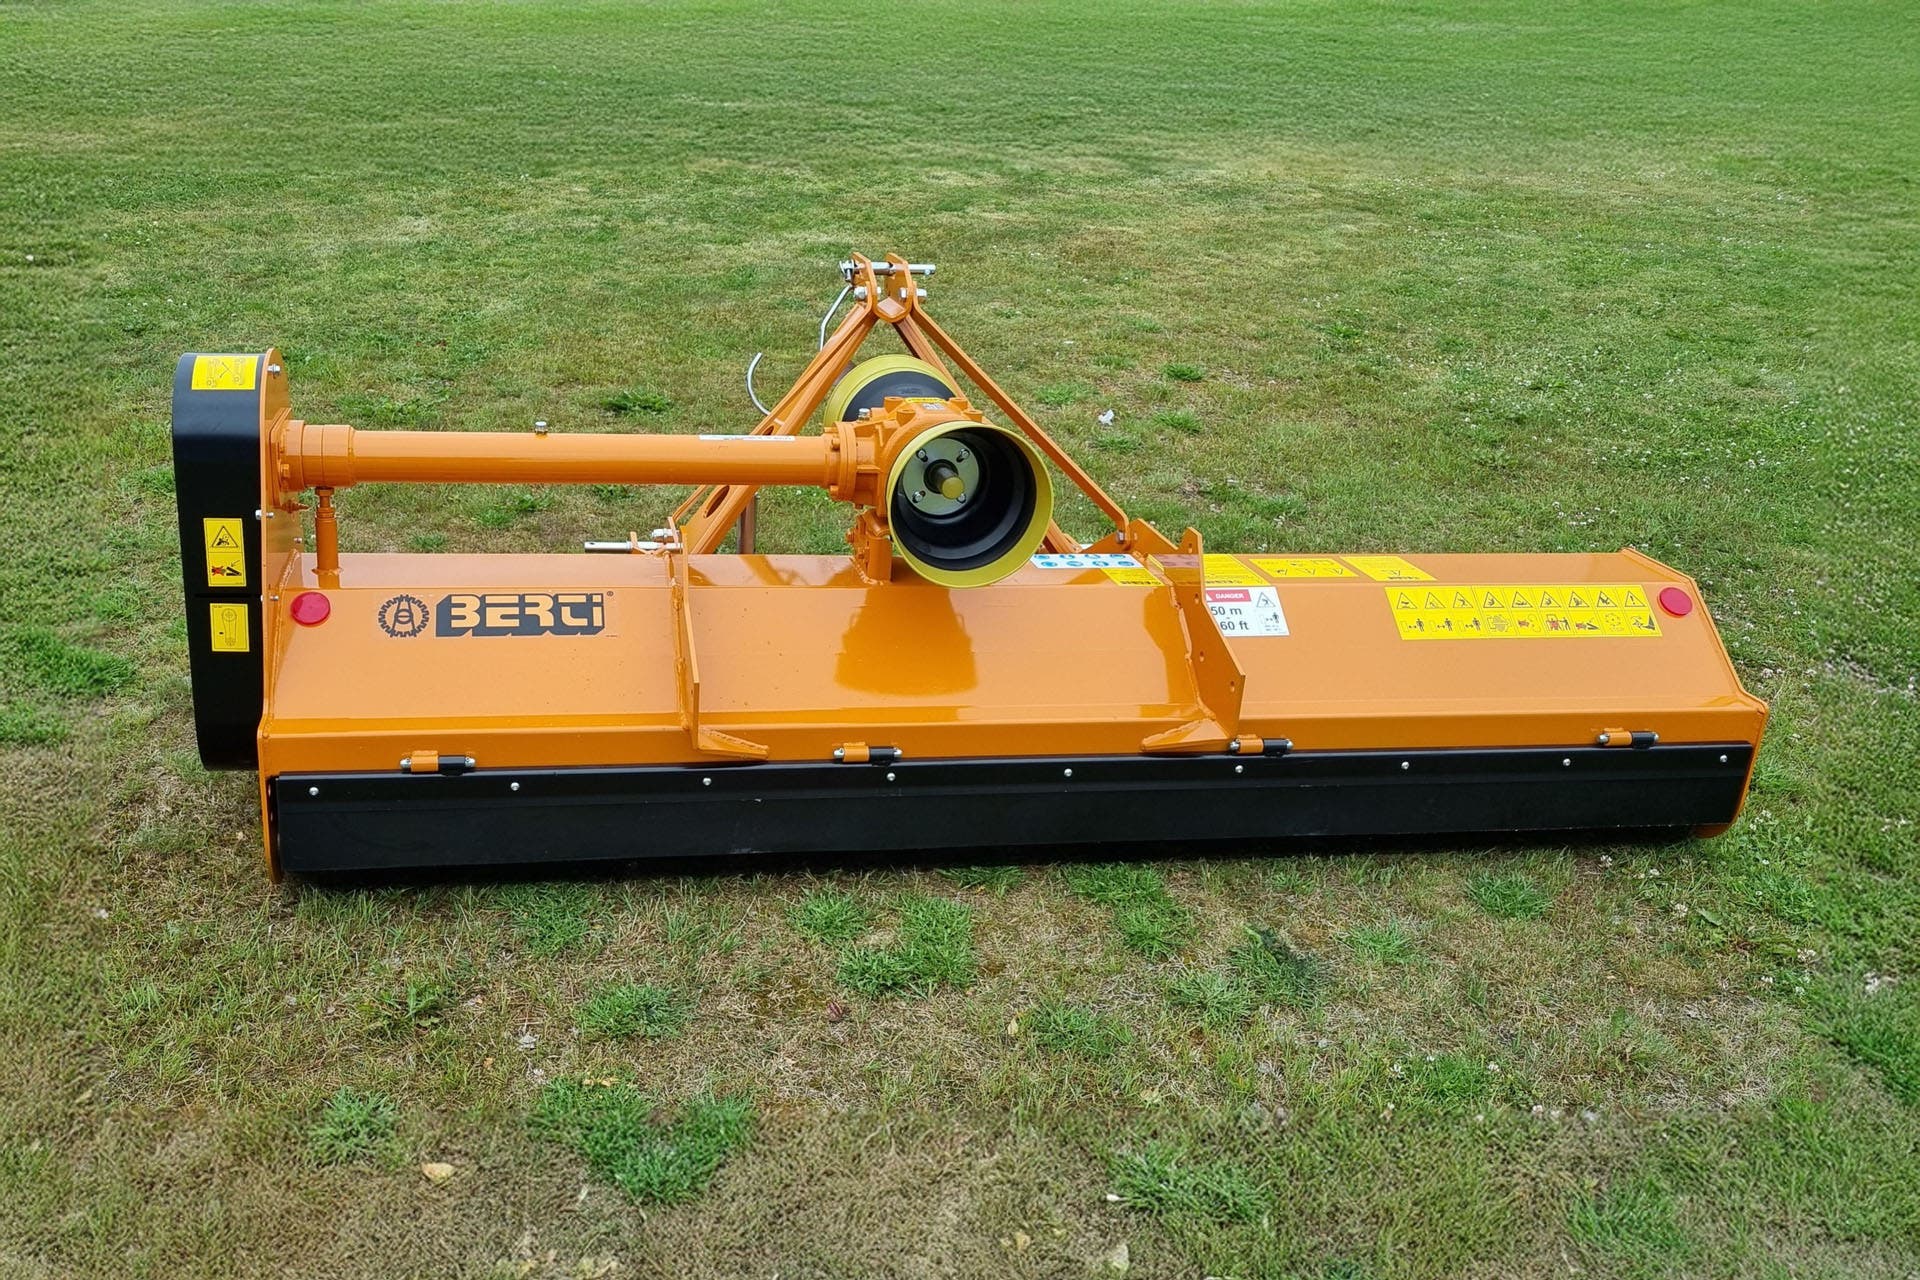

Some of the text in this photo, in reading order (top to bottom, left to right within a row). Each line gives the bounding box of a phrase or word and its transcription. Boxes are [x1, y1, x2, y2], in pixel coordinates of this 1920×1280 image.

[1210, 606, 1243, 616] 50 m
[1239, 620, 1250, 631] ft
